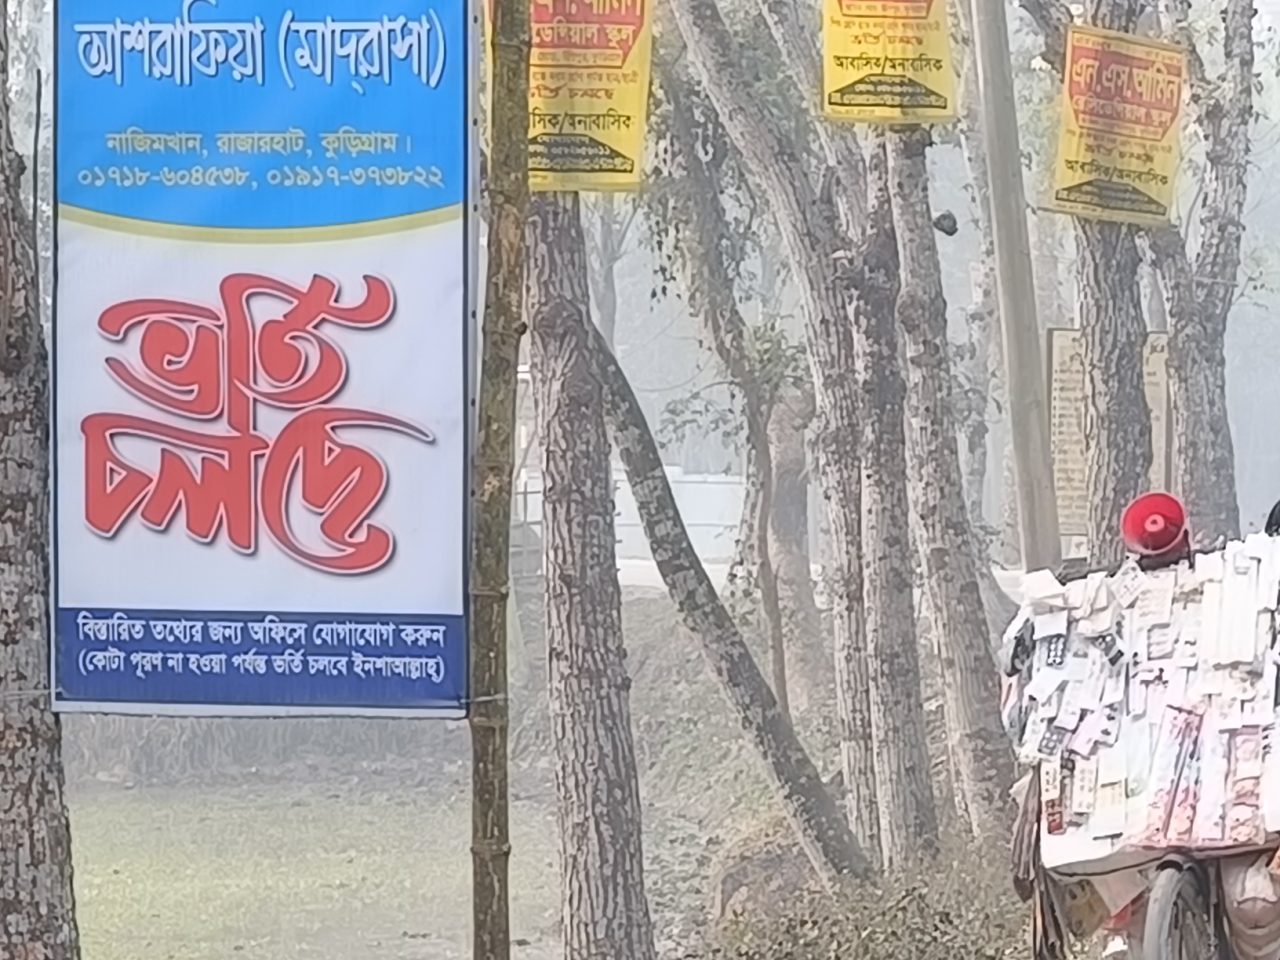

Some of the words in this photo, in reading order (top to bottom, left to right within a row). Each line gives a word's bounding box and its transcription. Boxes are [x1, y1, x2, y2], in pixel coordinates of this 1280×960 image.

[73, 0, 264, 86] আশরাফিয়া
[216, 127, 313, 158] রাজারহাট,
[96, 272, 397, 434] ভর্তি
[80, 404, 435, 575] চলছে
[77, 610, 146, 642] বিস্তারিত
[150, 618, 204, 644] তথ্যের
[208, 621, 244, 645] জন্য
[249, 615, 308, 646] অফিসে
[311, 621, 396, 647] যোগাযোগ
[400, 624, 446, 648] করুন
[78, 646, 124, 675] (কোটা
[130, 652, 163, 679] পূরণ
[167, 653, 182, 673] না
[187, 653, 227, 676] হওয়া
[232, 648, 268, 676] পর্যন্ত
[272, 646, 304, 676] ভর্তি
[307, 657, 348, 676] চলবে
